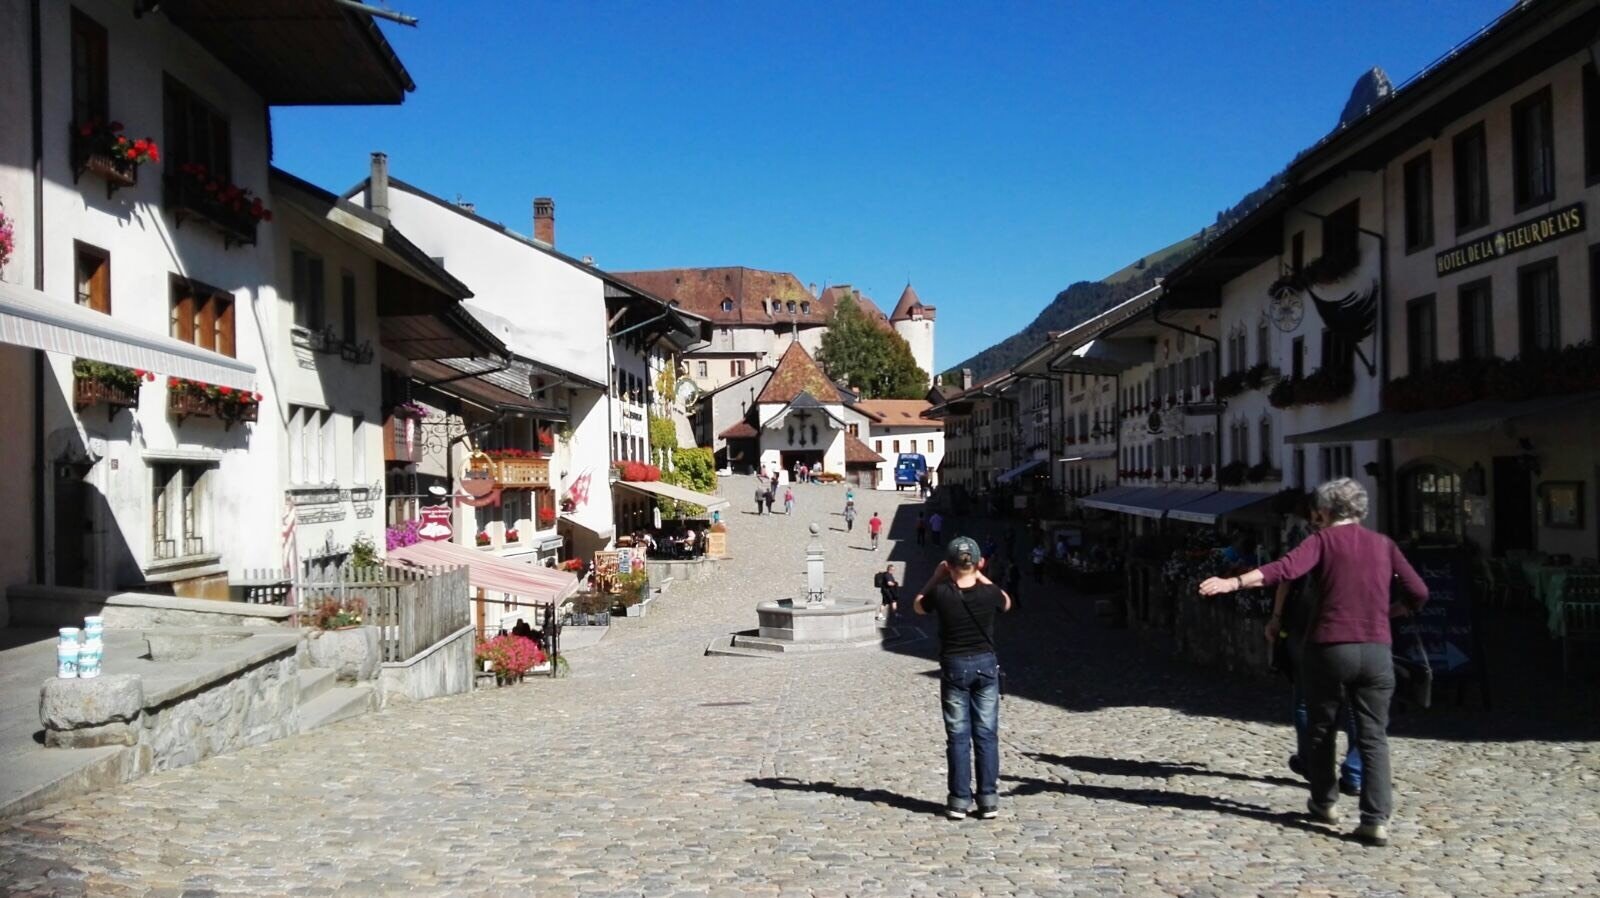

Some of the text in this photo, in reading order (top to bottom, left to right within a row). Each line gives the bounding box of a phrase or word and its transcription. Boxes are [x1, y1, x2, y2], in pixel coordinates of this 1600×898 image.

[1438, 208, 1580, 272] HOTEL DE LA FLEUR DE LYS
